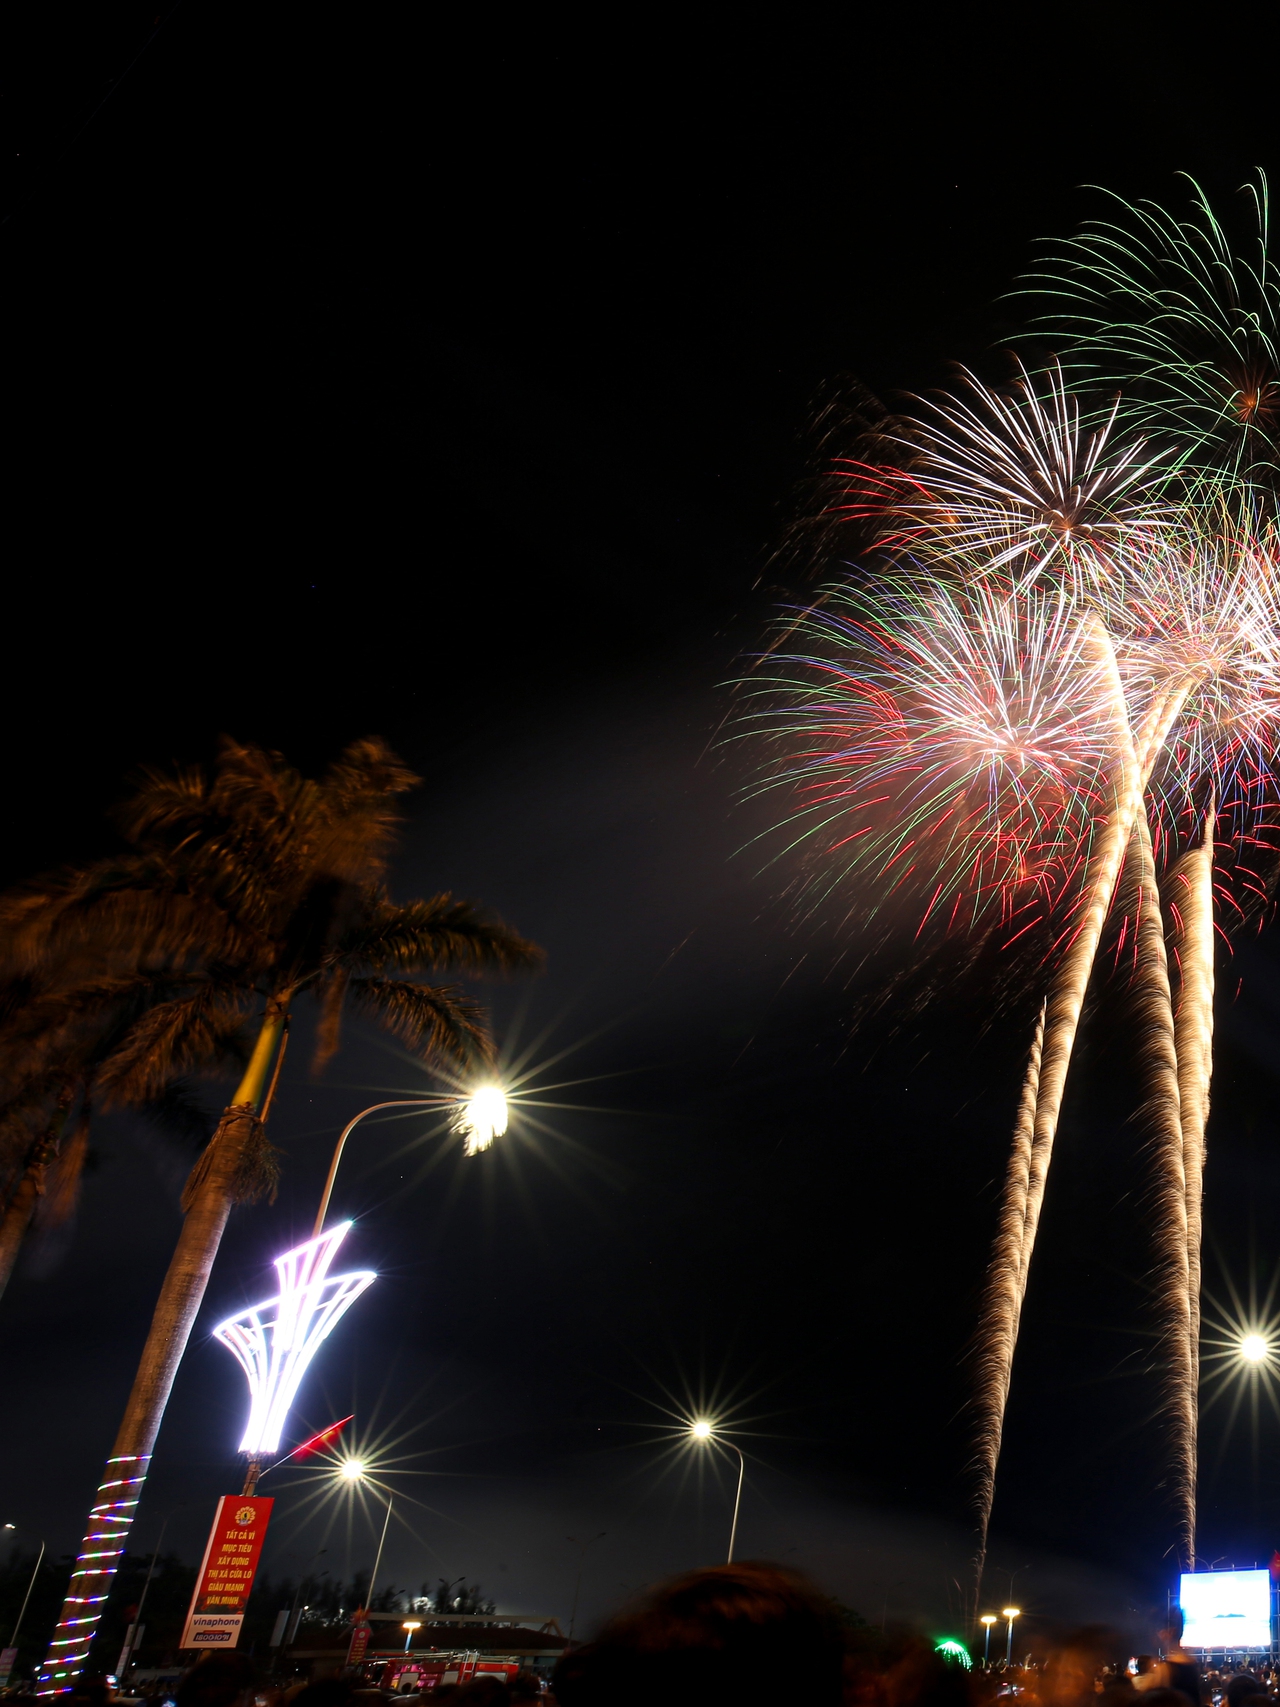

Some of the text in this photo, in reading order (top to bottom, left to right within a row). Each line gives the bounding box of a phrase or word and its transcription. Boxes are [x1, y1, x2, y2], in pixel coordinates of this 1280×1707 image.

[226, 1529, 255, 1540] TẤT CẢ VÌ
[222, 1543, 252, 1553] MỤC TIÊU
[217, 1555, 249, 1567] XÂY DỰNG
[208, 1568, 252, 1580] THỊ XÃ CỬA LÒ
[208, 1581, 245, 1593] GIÀU MẠNH
[207, 1595, 239, 1604] VĂN MINH
[194, 1618, 240, 1627] vinaphone
